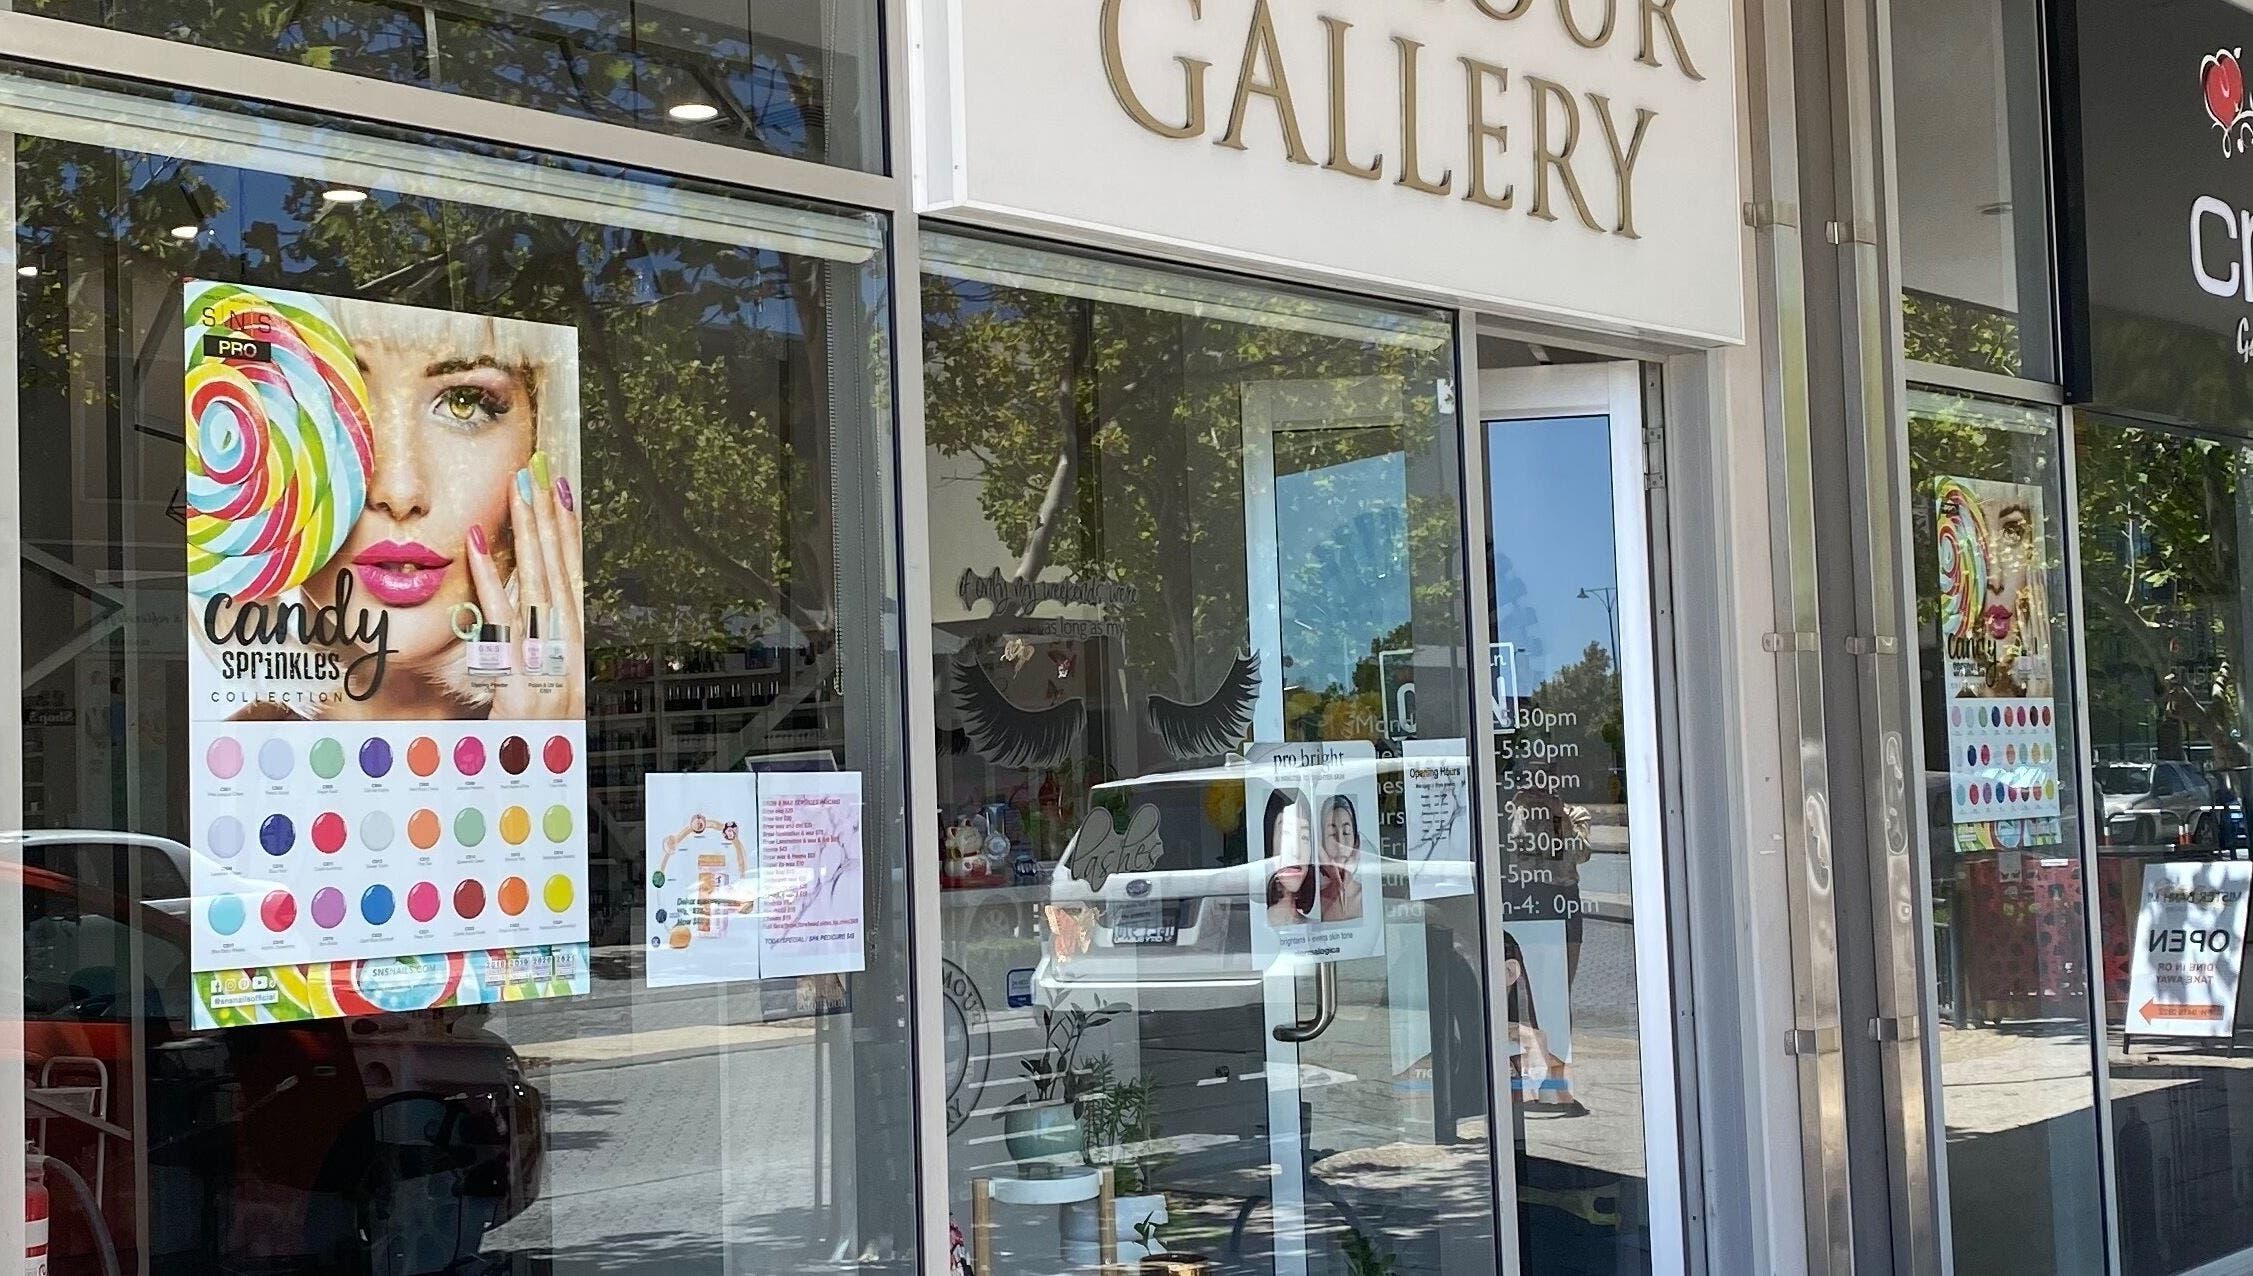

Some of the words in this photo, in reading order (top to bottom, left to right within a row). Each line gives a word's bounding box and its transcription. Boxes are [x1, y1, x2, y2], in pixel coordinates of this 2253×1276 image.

[1100, 0, 1658, 240] GALLERY
[218, 340, 257, 358] PRO
[1060, 616, 1086, 639] long
[1091, 623, 1103, 634] as
[211, 691, 343, 703] COLLECTION
[1273, 754, 1297, 772] pro
[1300, 747, 1344, 772] bright
[1494, 739, 1579, 763] -5:30pm
[1496, 770, 1580, 794] -5:30pm
[1071, 804, 1162, 893] lashes
[1499, 832, 1583, 857] -5:30pm
[1500, 864, 1553, 889] -5pm
